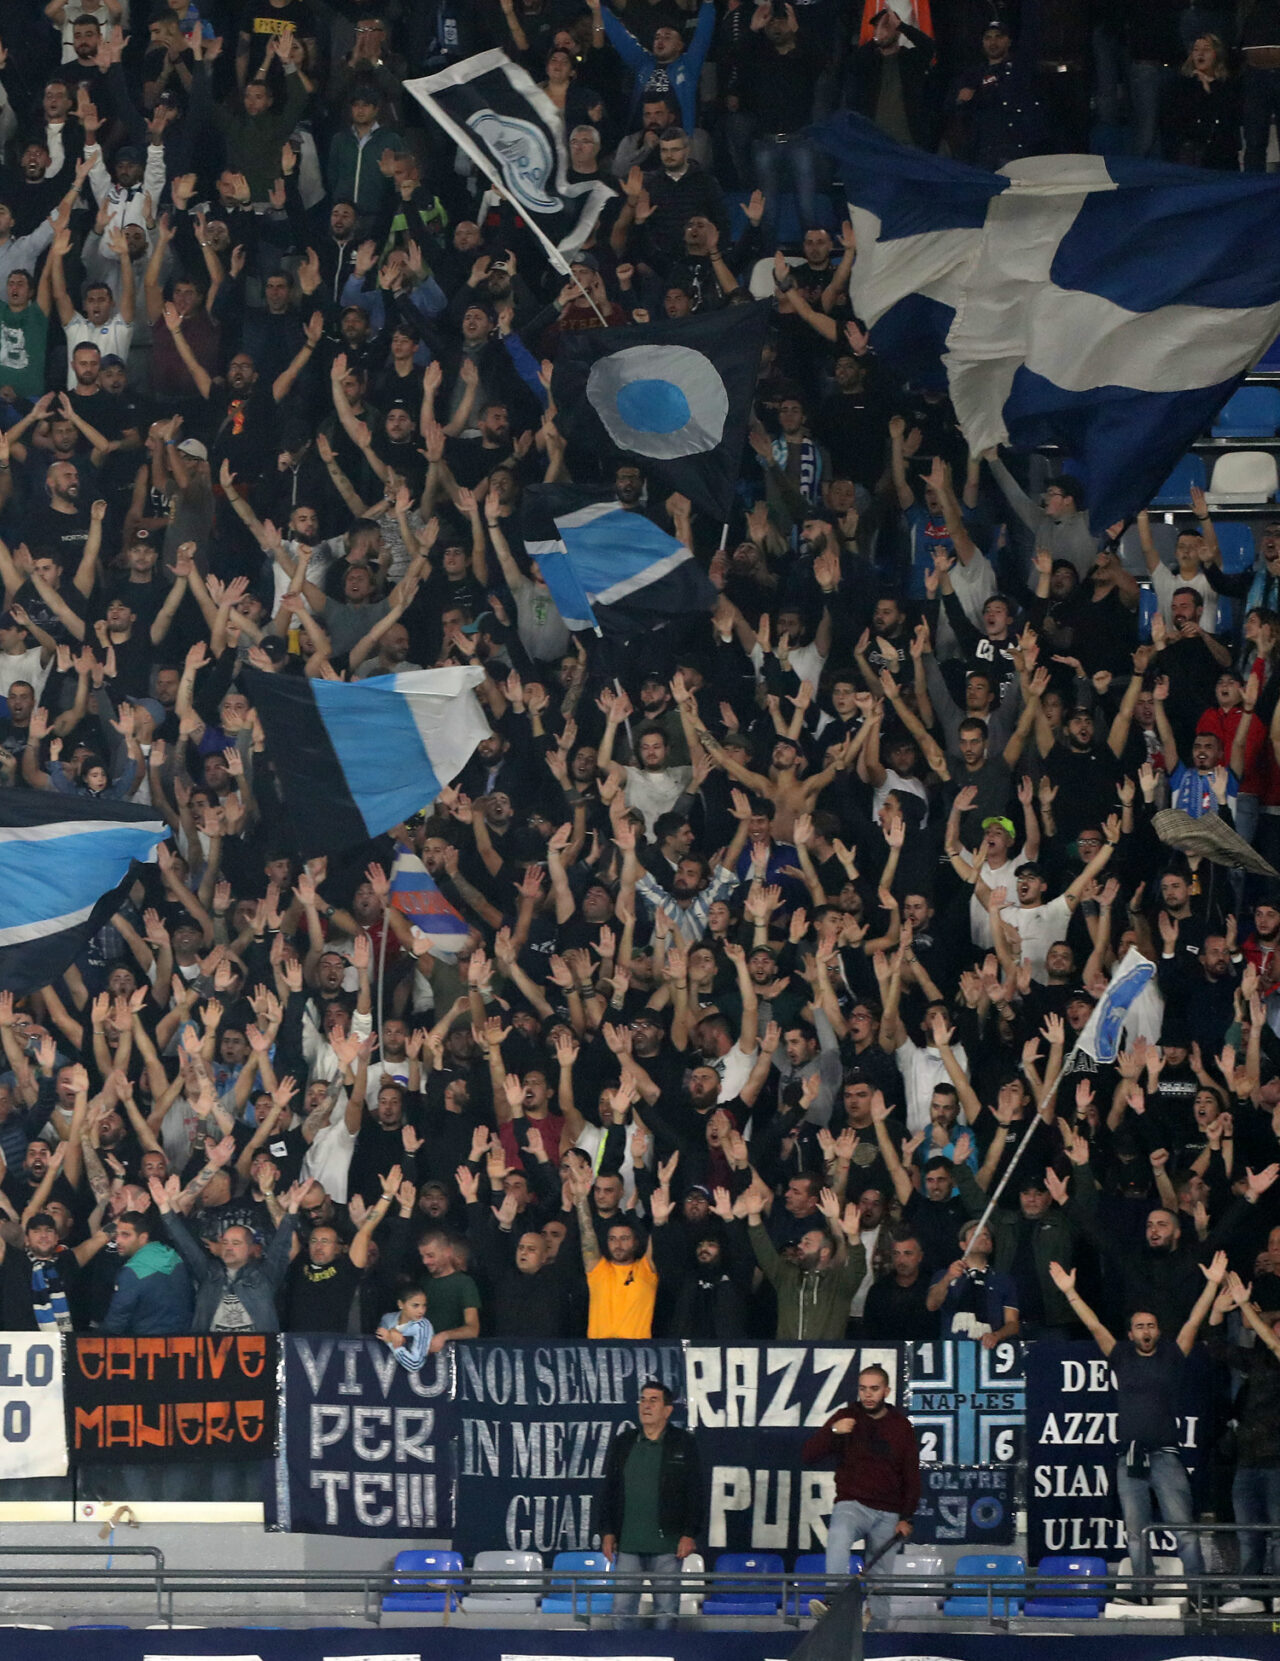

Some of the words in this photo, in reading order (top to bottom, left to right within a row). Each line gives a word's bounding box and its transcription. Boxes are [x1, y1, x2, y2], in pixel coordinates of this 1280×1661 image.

[75, 1335, 266, 1381] CATTIVE
[460, 1345, 527, 1406] NOI
[534, 1345, 683, 1405] SEMPRE
[917, 1342, 934, 1374] 1
[995, 1343, 1015, 1373] 9
[1061, 1360, 1119, 1392] DE
[74, 1400, 265, 1449] MANIERE
[921, 1394, 1015, 1410] NAPLES
[310, 1405, 435, 1463] PER
[461, 1418, 502, 1478] IN
[919, 1431, 937, 1461] 2
[995, 1430, 1014, 1461] 6
[929, 1472, 1006, 1490] OLTRE
[506, 1495, 601, 1552] GUAI.
